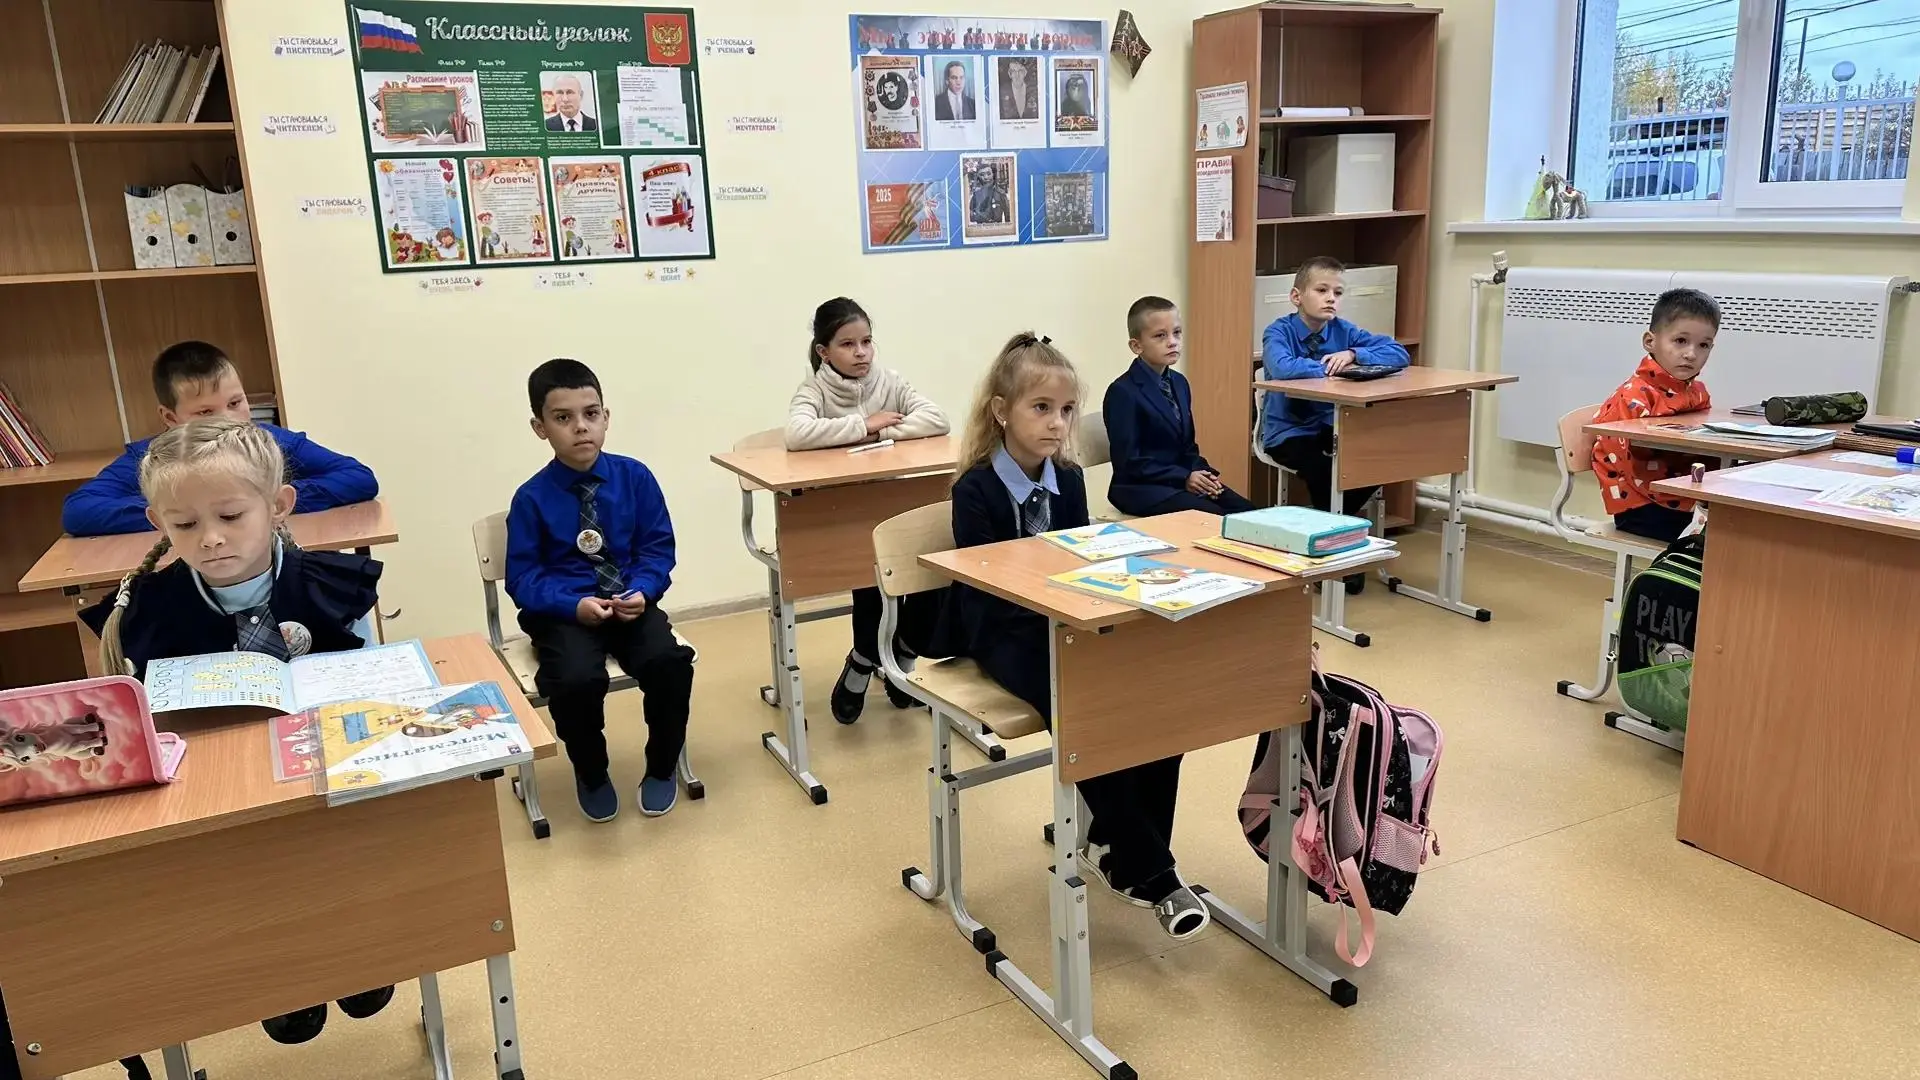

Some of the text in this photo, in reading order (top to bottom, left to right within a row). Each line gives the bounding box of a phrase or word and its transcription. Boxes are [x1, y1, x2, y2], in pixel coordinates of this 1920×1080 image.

[425, 16, 632, 50] Классный уголок
[406, 75, 473, 84] Расписание уроков
[493, 175, 535, 185] Советы:
[876, 188, 892, 202] 2025
[1636, 593, 1693, 643] PLAY
[354, 731, 509, 766] Математика
